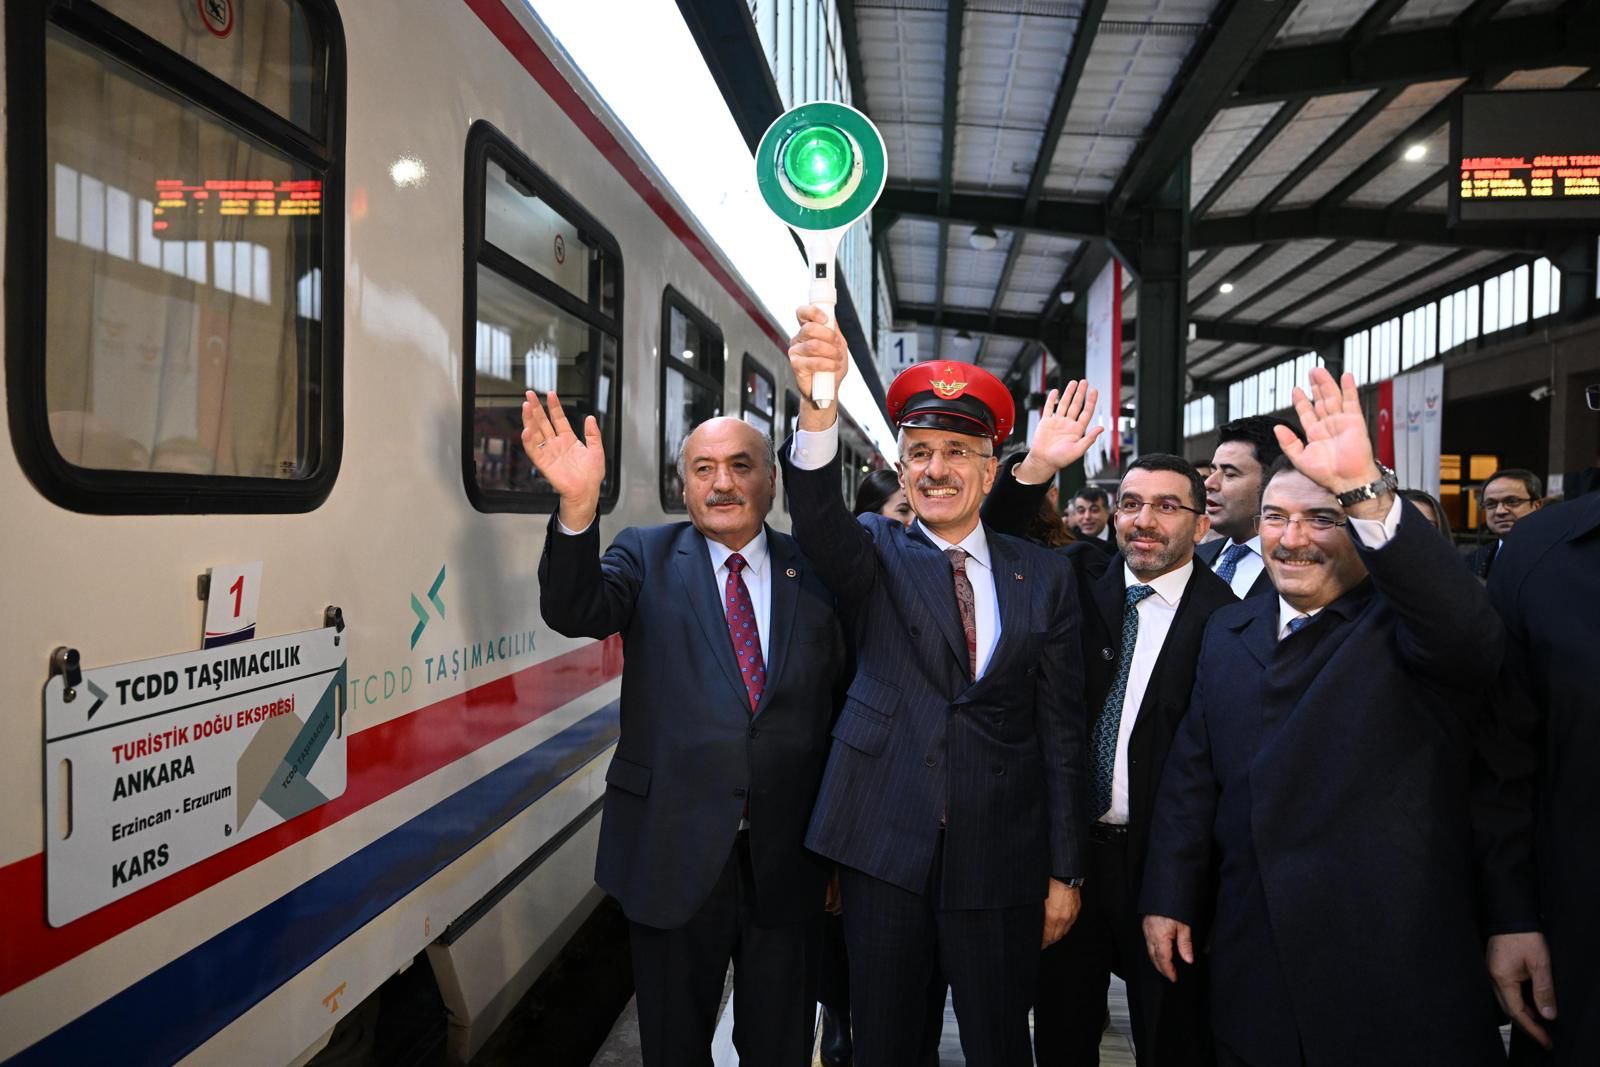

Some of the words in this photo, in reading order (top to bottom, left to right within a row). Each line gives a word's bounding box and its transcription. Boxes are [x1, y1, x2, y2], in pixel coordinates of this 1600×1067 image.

[893, 337, 914, 364] 1.
[229, 575, 244, 618] 1
[116, 671, 179, 706] TCDD
[184, 645, 301, 691] TAŞIMACILIK
[350, 666, 413, 710] TCDD
[424, 630, 537, 685] TAŞIMACILIK
[112, 725, 190, 764] TURİSTİK
[193, 714, 233, 741] DOĞU
[236, 693, 295, 728] EKSPRESİ
[112, 755, 195, 802] ANKARA
[112, 807, 172, 842] Erzincan
[183, 786, 232, 814] Erzurum
[112, 843, 169, 888] KARS
